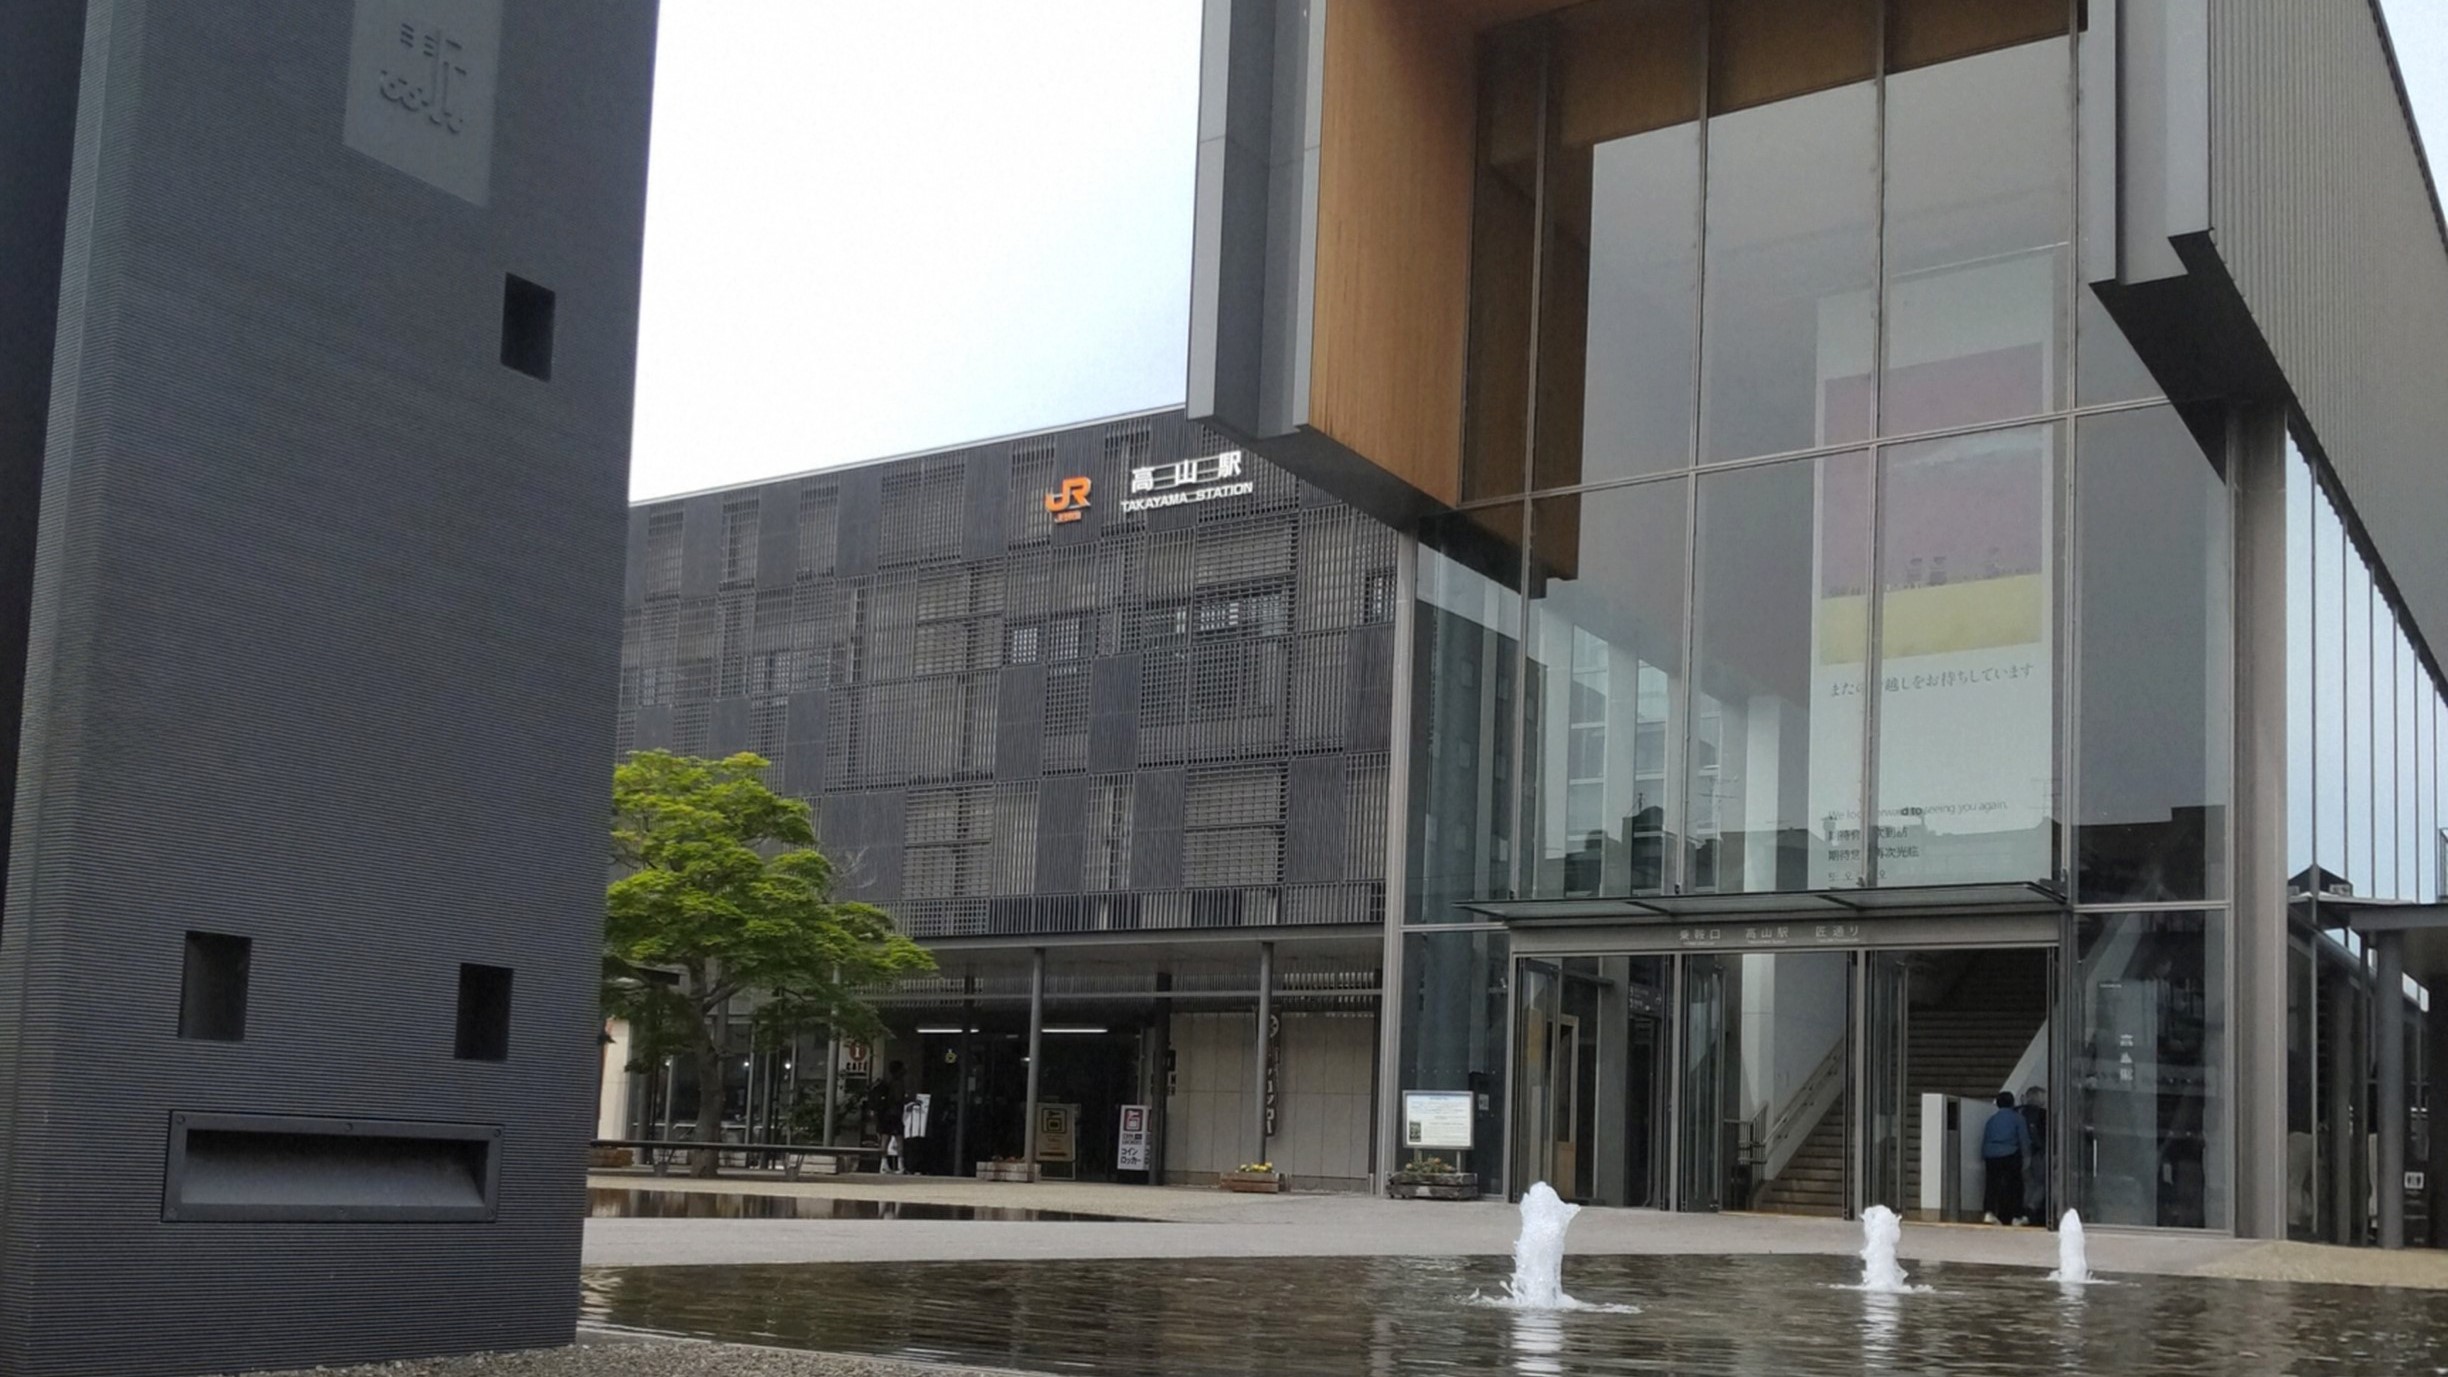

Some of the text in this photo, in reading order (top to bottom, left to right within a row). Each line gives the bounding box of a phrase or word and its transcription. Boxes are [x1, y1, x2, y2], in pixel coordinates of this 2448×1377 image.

[1131, 450, 1242, 494] 高山駅
[1045, 475, 1092, 512] JR
[1121, 481, 1254, 513] TAKAYAMA STATION
[1830, 663, 2035, 697] またの越しをお待ちしています
[1911, 806, 1923, 817] to
[1744, 926, 1789, 940] 高山駅
[1815, 925, 1860, 938] 匠通り
[1121, 1147, 1139, 1156] コイン
[1120, 1156, 1142, 1165] ロッカー
